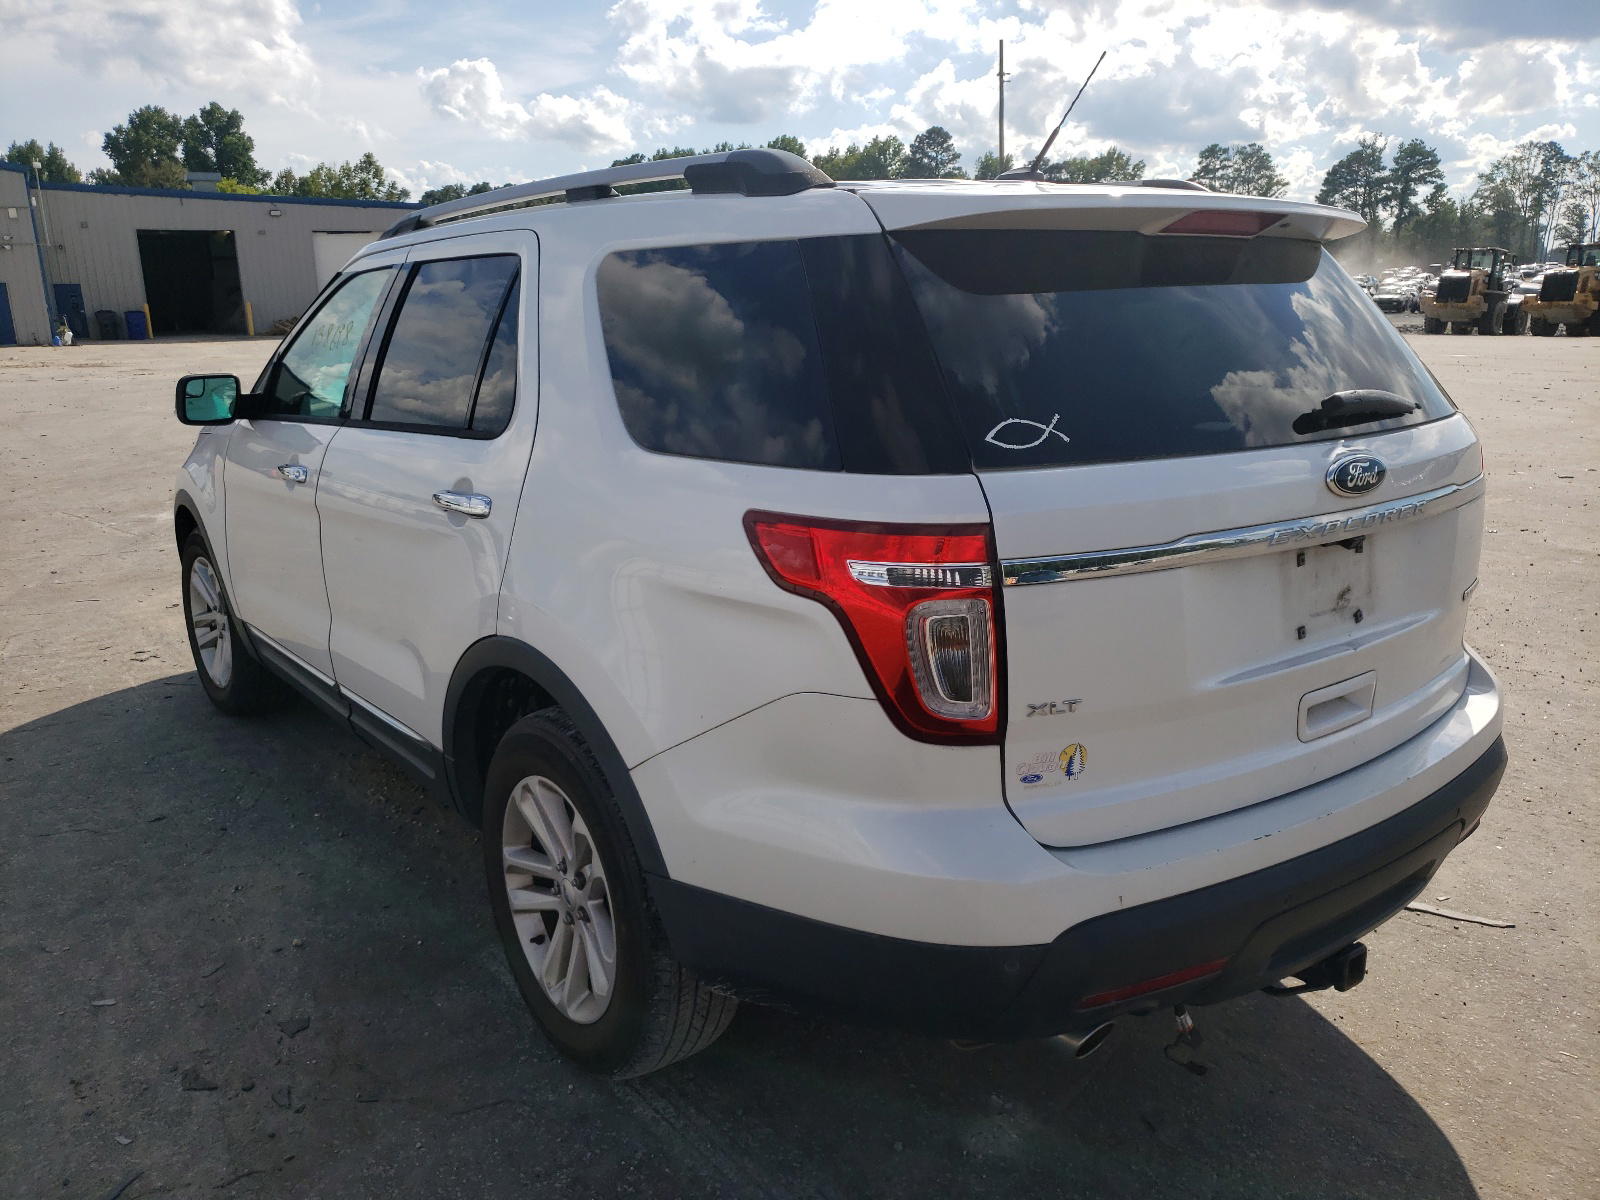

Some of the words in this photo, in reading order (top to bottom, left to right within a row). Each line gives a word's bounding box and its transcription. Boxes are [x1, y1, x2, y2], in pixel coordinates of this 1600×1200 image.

[1347, 461, 1378, 488] Ford
[1269, 500, 1427, 546] EXPLORER
[1026, 698, 1083, 717] XLT
